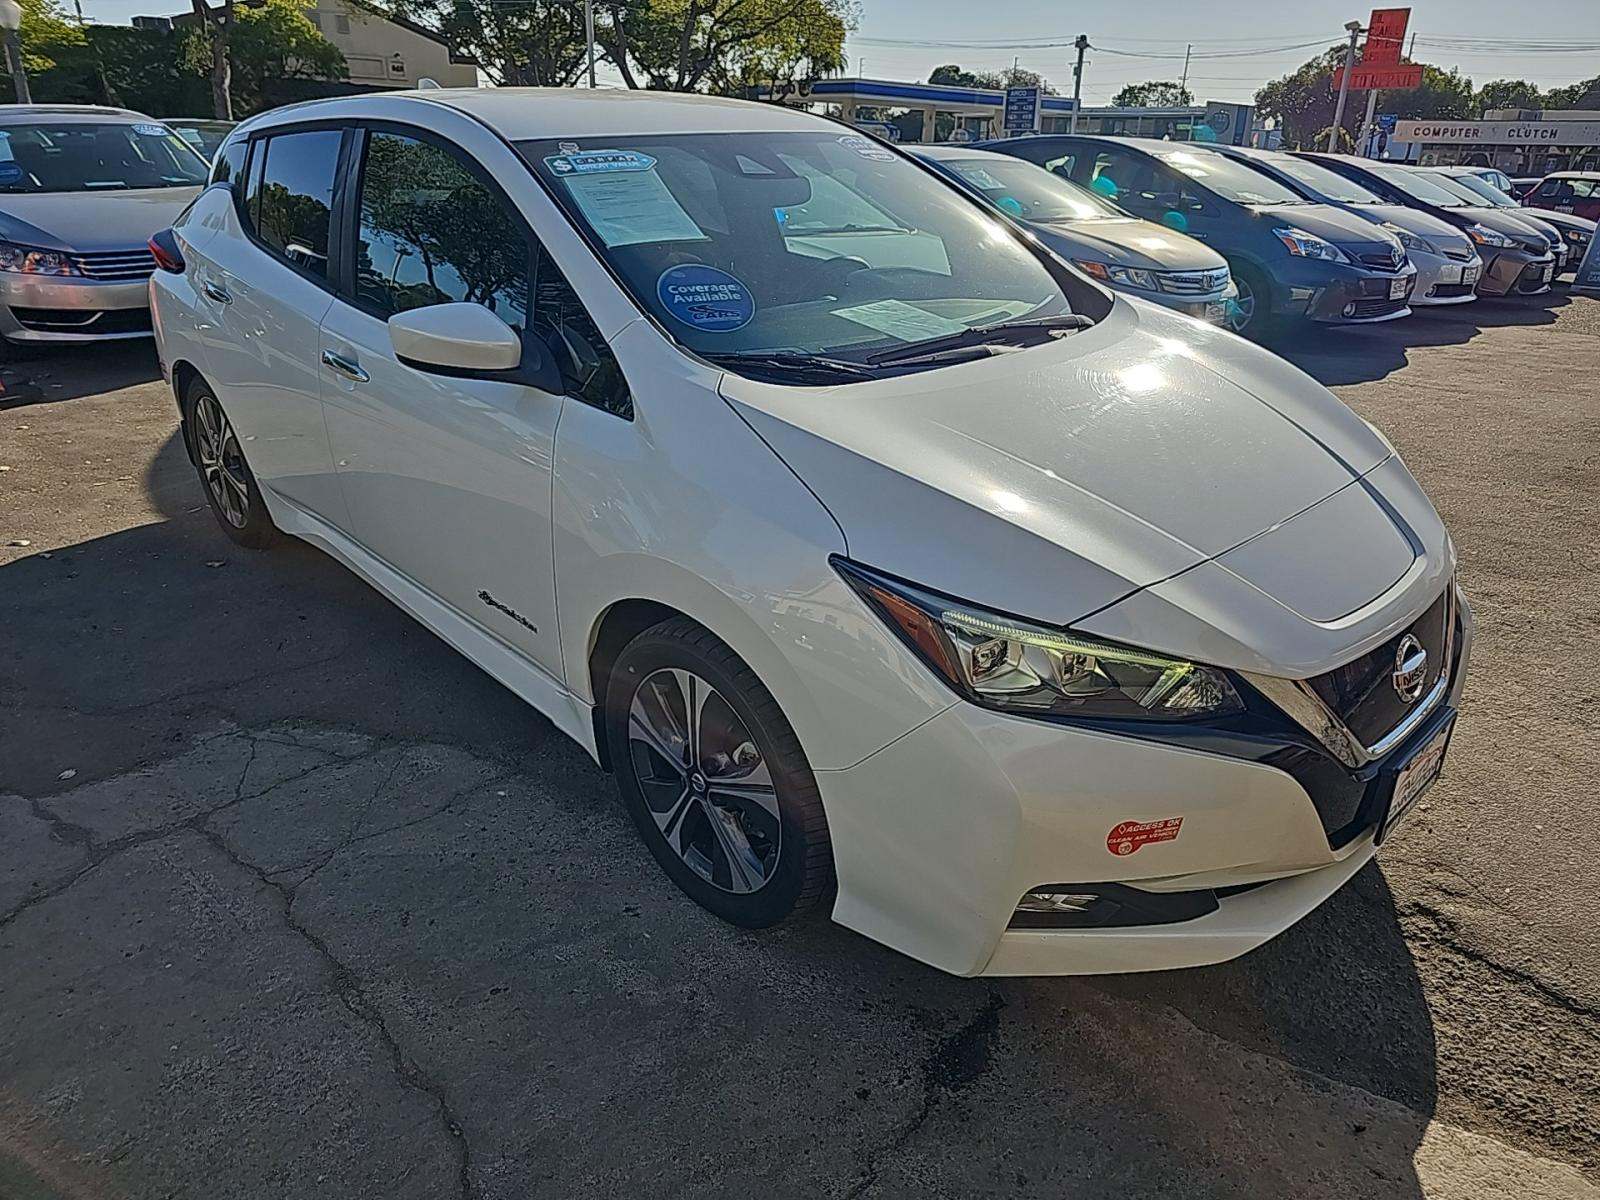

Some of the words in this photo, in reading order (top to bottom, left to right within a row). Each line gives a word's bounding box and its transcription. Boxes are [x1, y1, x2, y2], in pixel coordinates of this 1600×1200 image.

[1413, 127, 1480, 138] COMPUTER
[1508, 129, 1558, 139] CLUTCH
[668, 284, 738, 294] Coverage
[674, 290, 742, 303] Available
[1126, 821, 1165, 833] ACCESS
[1167, 819, 1180, 827] OK
[1108, 836, 1133, 844] CLEAN
